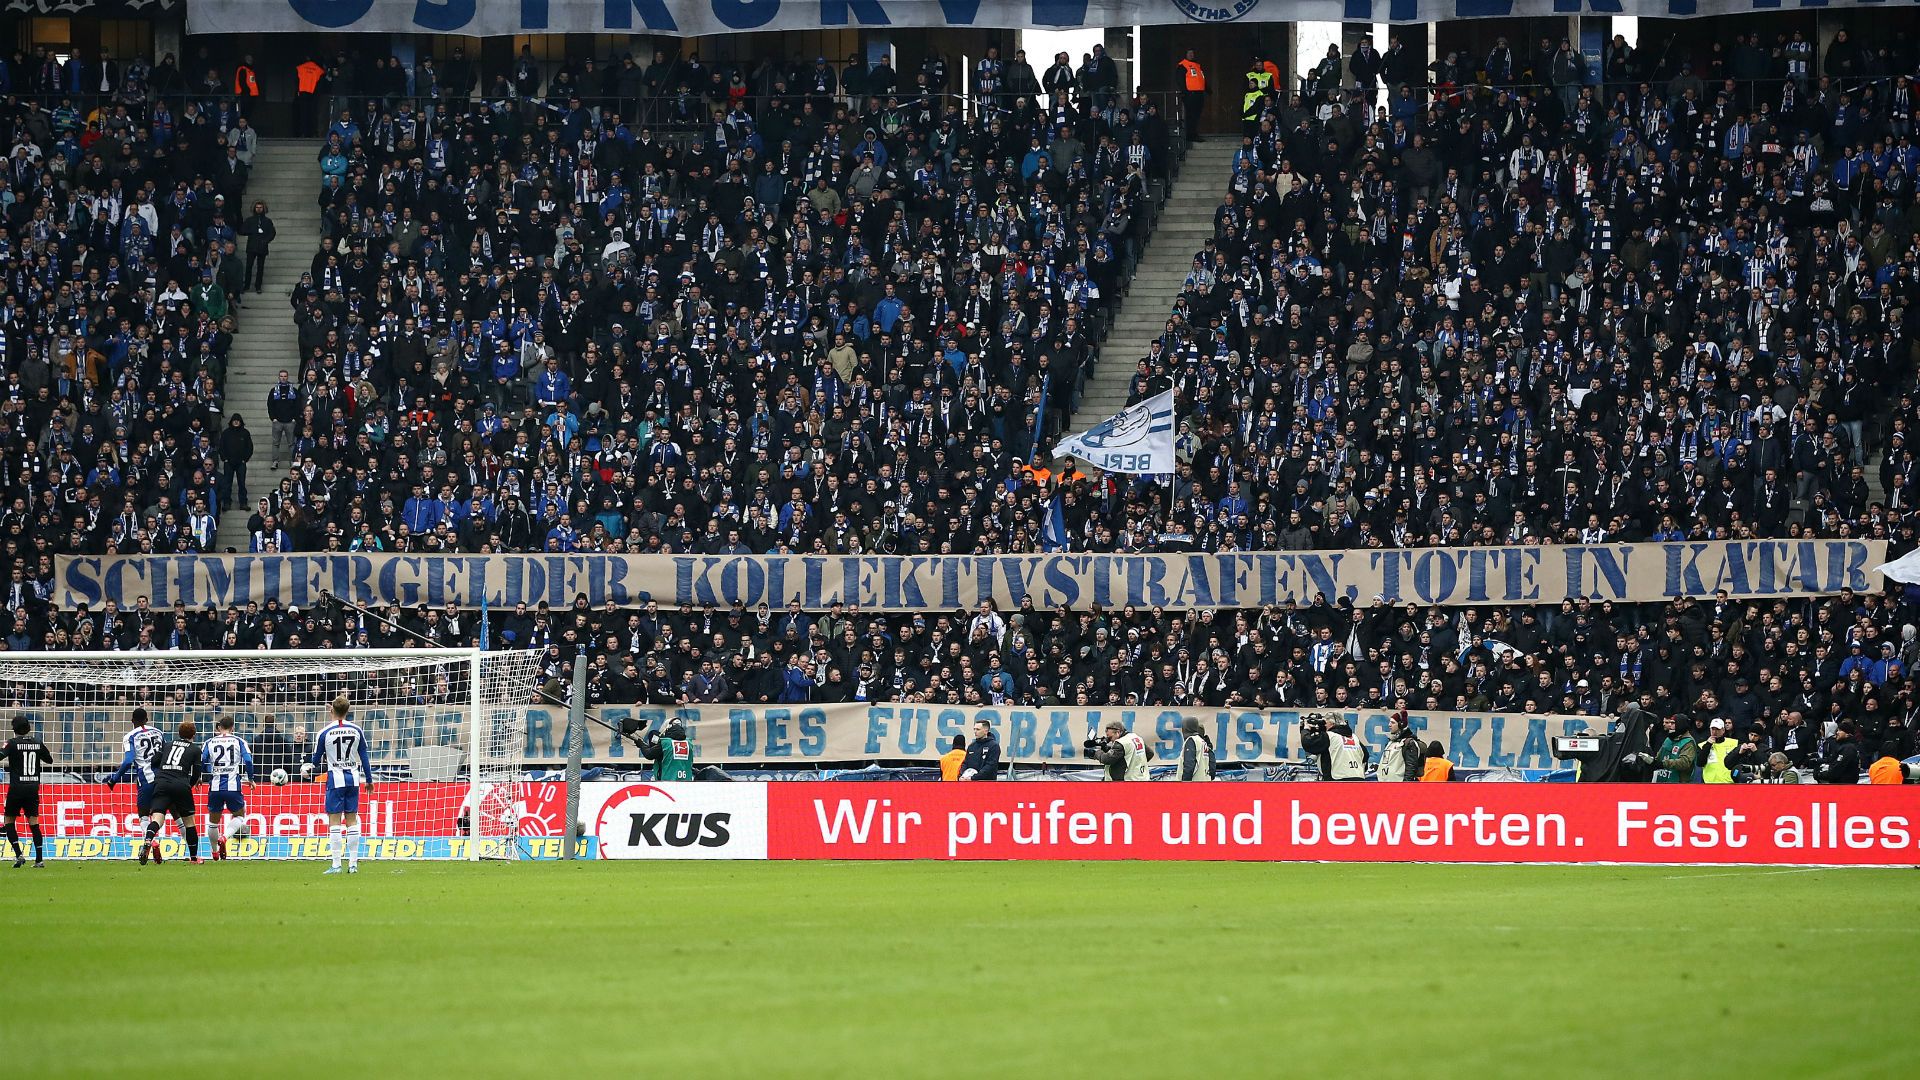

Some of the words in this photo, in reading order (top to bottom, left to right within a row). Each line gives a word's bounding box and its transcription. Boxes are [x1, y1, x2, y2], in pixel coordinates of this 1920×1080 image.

[1177, 0, 1231, 19] ERTHA
[65, 555, 651, 608] SCHMIERGELDER,
[672, 554, 1359, 608] KOLLEKTIVSTRAFEN,
[1370, 547, 1540, 603] TOTE
[1562, 546, 1635, 600] IN
[1662, 541, 1870, 597] KATAR
[727, 707, 828, 758] DES
[166, 746, 185, 766] 19
[213, 745, 235, 767] 21
[333, 736, 355, 761] 17
[23, 751, 37, 776] 10
[677, 770, 687, 779] 06
[628, 813, 731, 847] KÜS
[814, 799, 921, 844] Wir
[948, 799, 1133, 856] prüfen
[1161, 800, 1262, 845] und
[1290, 800, 1584, 847] bewerten.
[1617, 801, 1748, 848] Fast
[1774, 802, 1920, 849] alles
[54, 838, 112, 857] TEDi
[366, 837, 424, 857] TEDi
